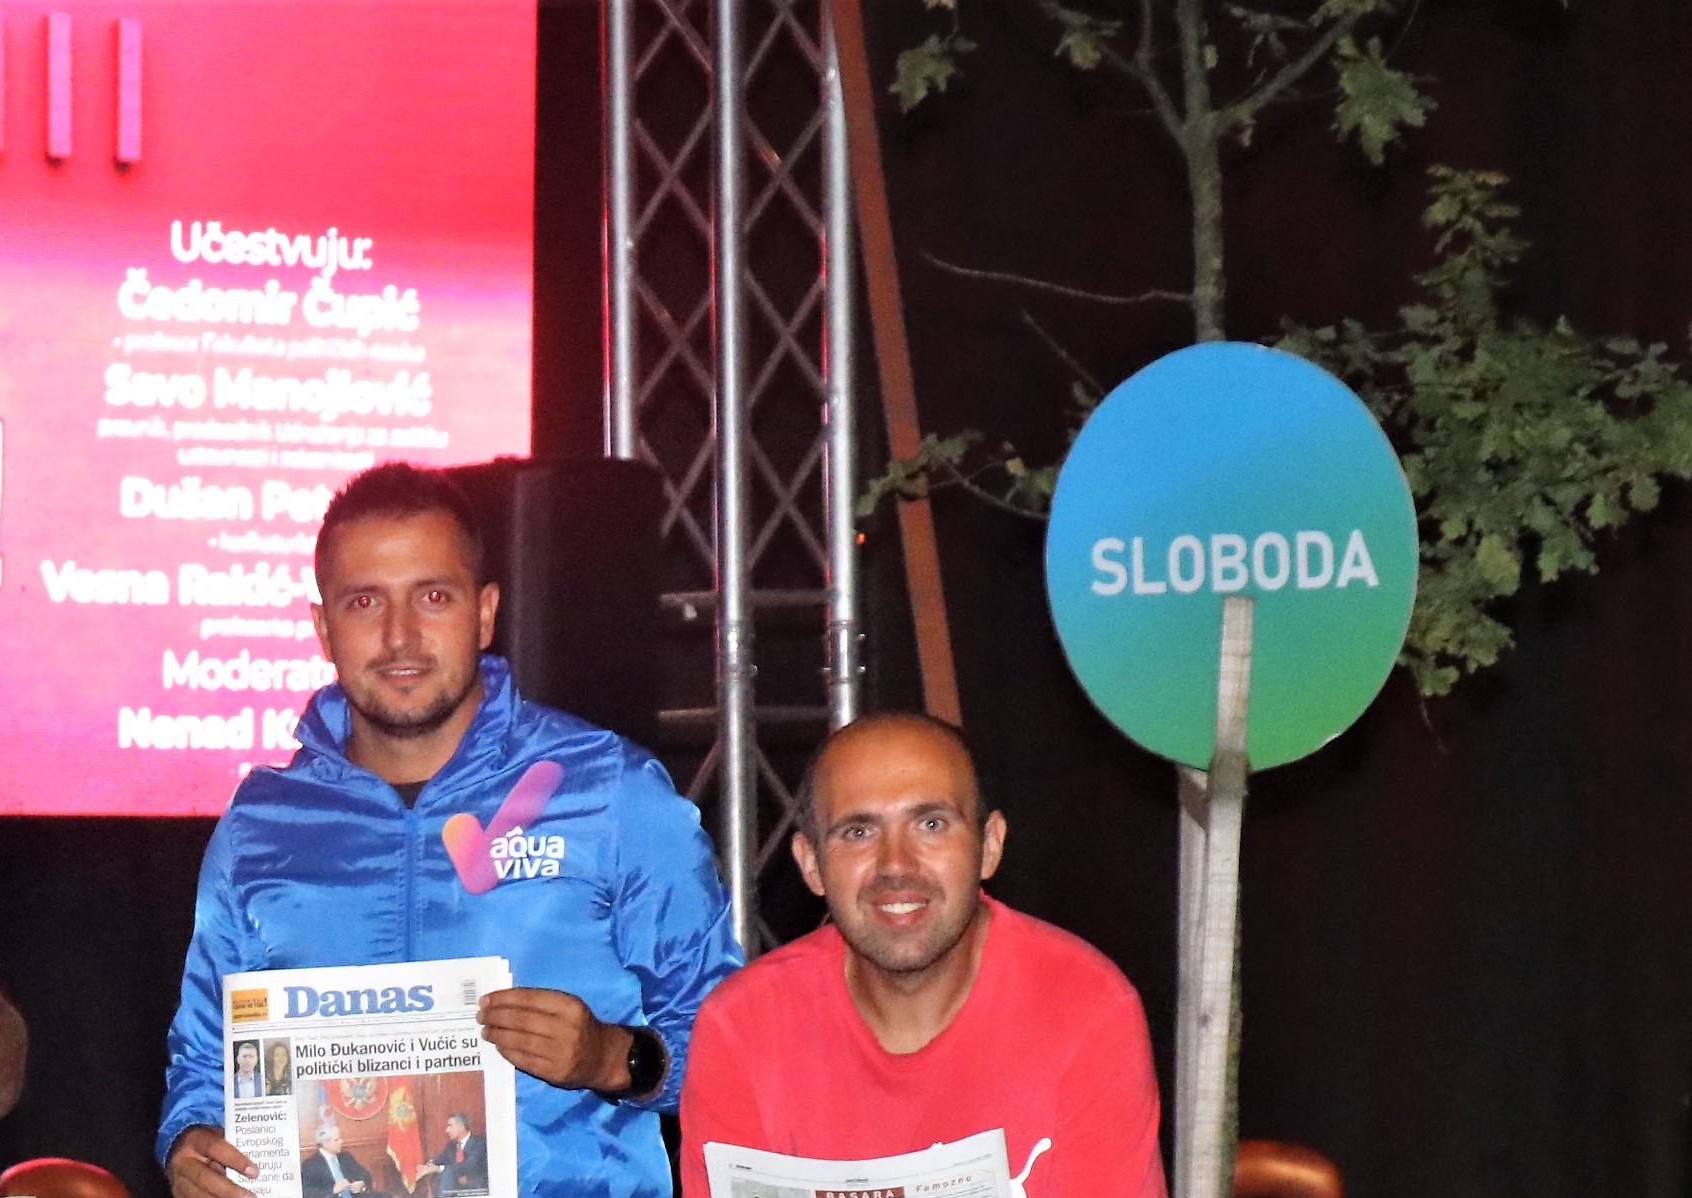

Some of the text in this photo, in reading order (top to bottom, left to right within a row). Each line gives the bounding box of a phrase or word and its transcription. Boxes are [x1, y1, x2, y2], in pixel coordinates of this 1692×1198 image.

[170, 220, 372, 278] Učestvuju:
[117, 267, 297, 325] Čedomir
[120, 476, 253, 520] Dušan
[1091, 529, 1380, 596] SLOBODA
[40, 559, 169, 603] Vesna
[118, 706, 254, 750] Nenad
[283, 984, 435, 1019] Danas
[296, 1036, 478, 1058] Milo Đukanović i Vučić su
[296, 1052, 481, 1078] politički blizanci i partneri
[235, 1111, 287, 1123] Zelenović:
[236, 1126, 276, 1135] Poslanici
[237, 1136, 284, 1148] Evropskog
[244, 1148, 289, 1158] arlamenta
[282, 1172, 294, 1180] da
[916, 1175, 972, 1192] Famozno
